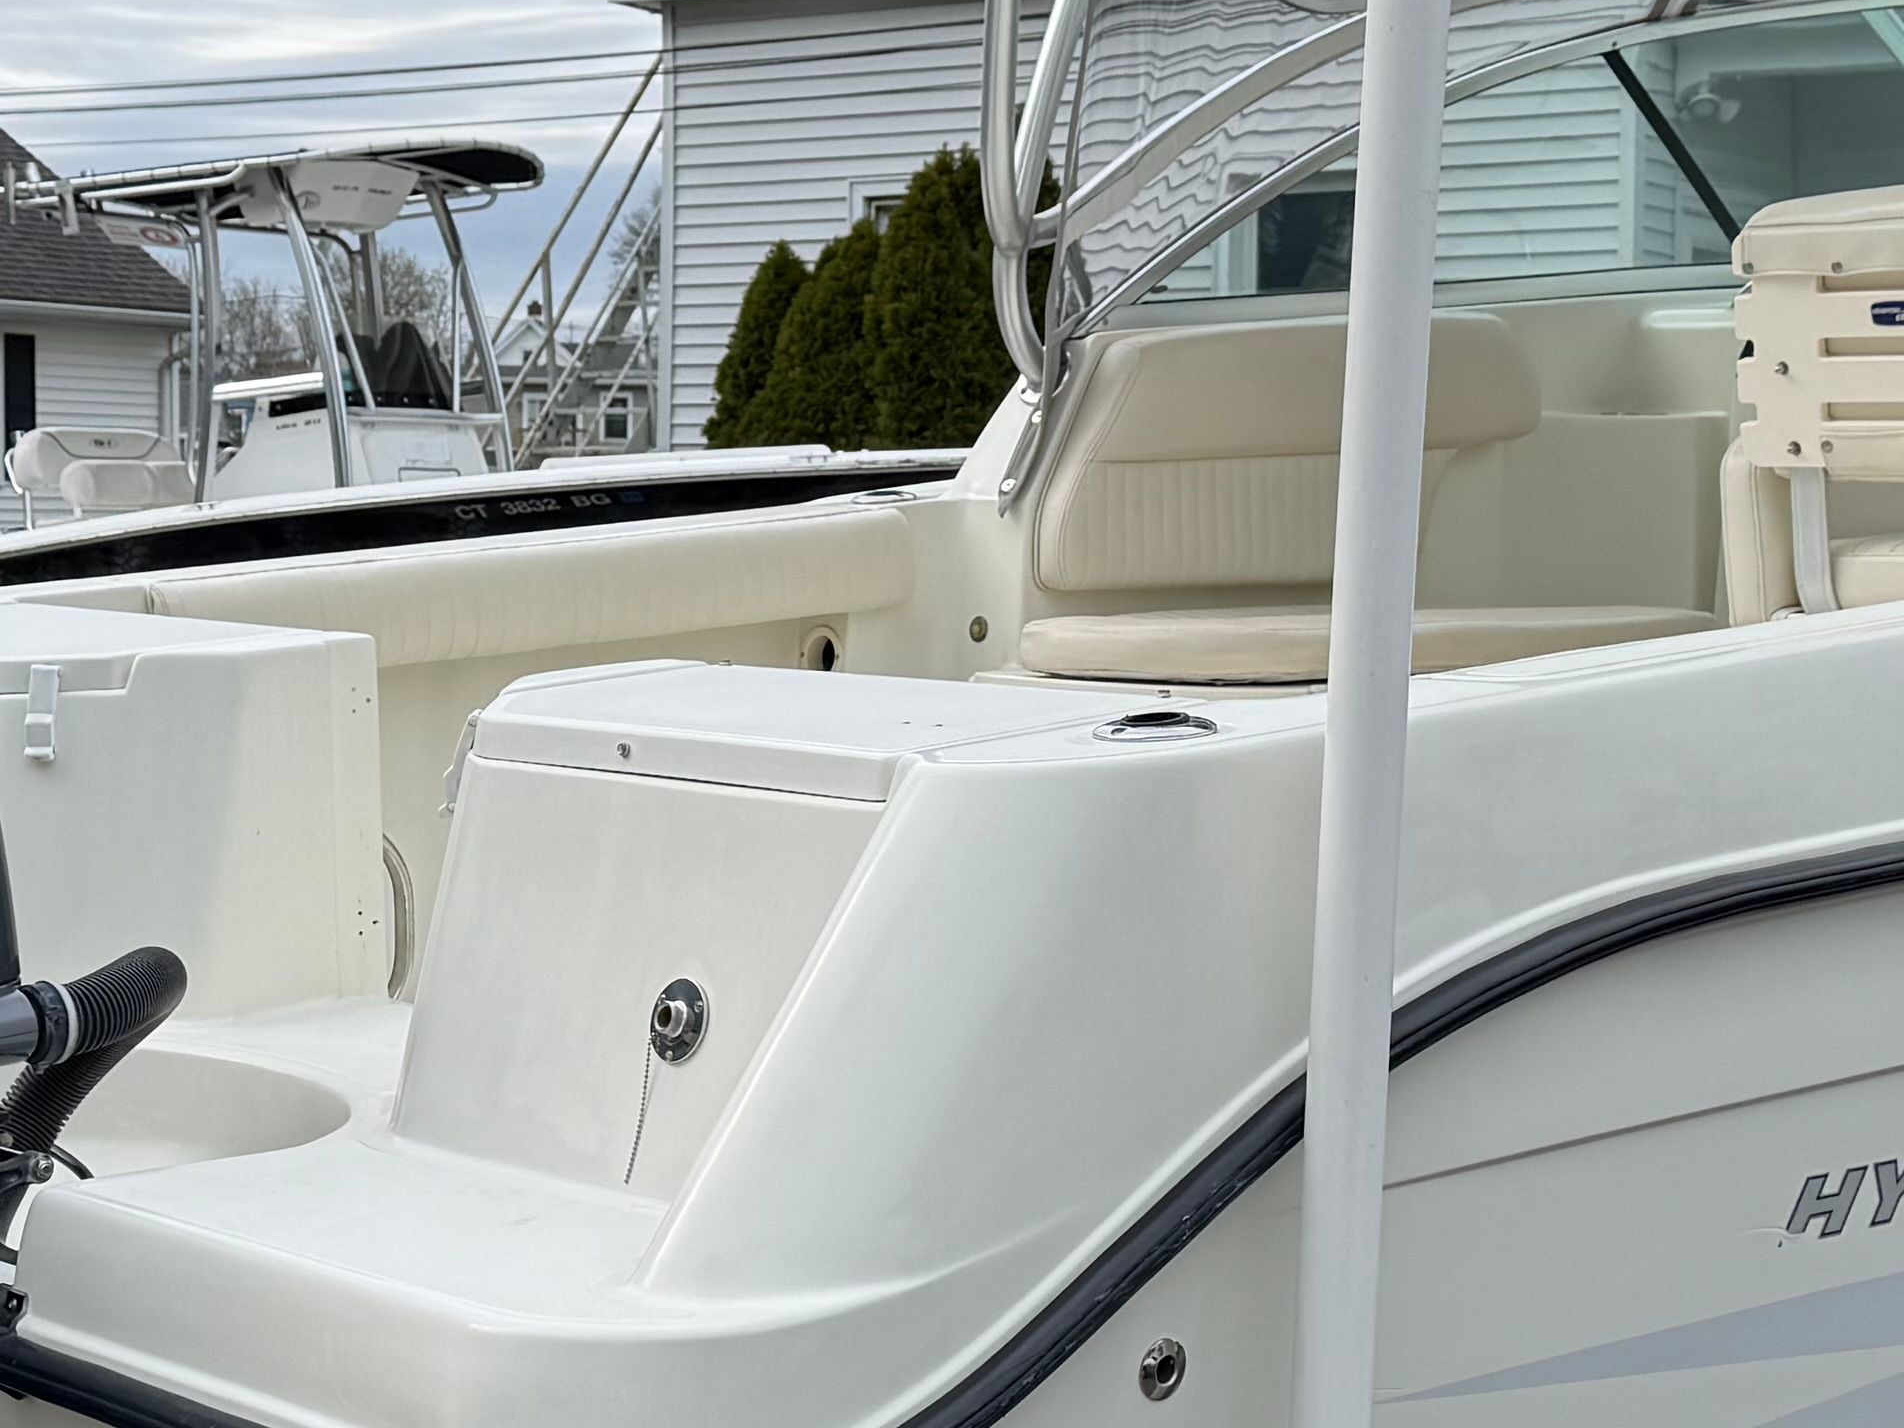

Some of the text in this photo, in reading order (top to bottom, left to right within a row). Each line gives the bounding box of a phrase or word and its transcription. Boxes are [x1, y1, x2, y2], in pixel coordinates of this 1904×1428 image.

[454, 493, 613, 520] CT 3832 BG
